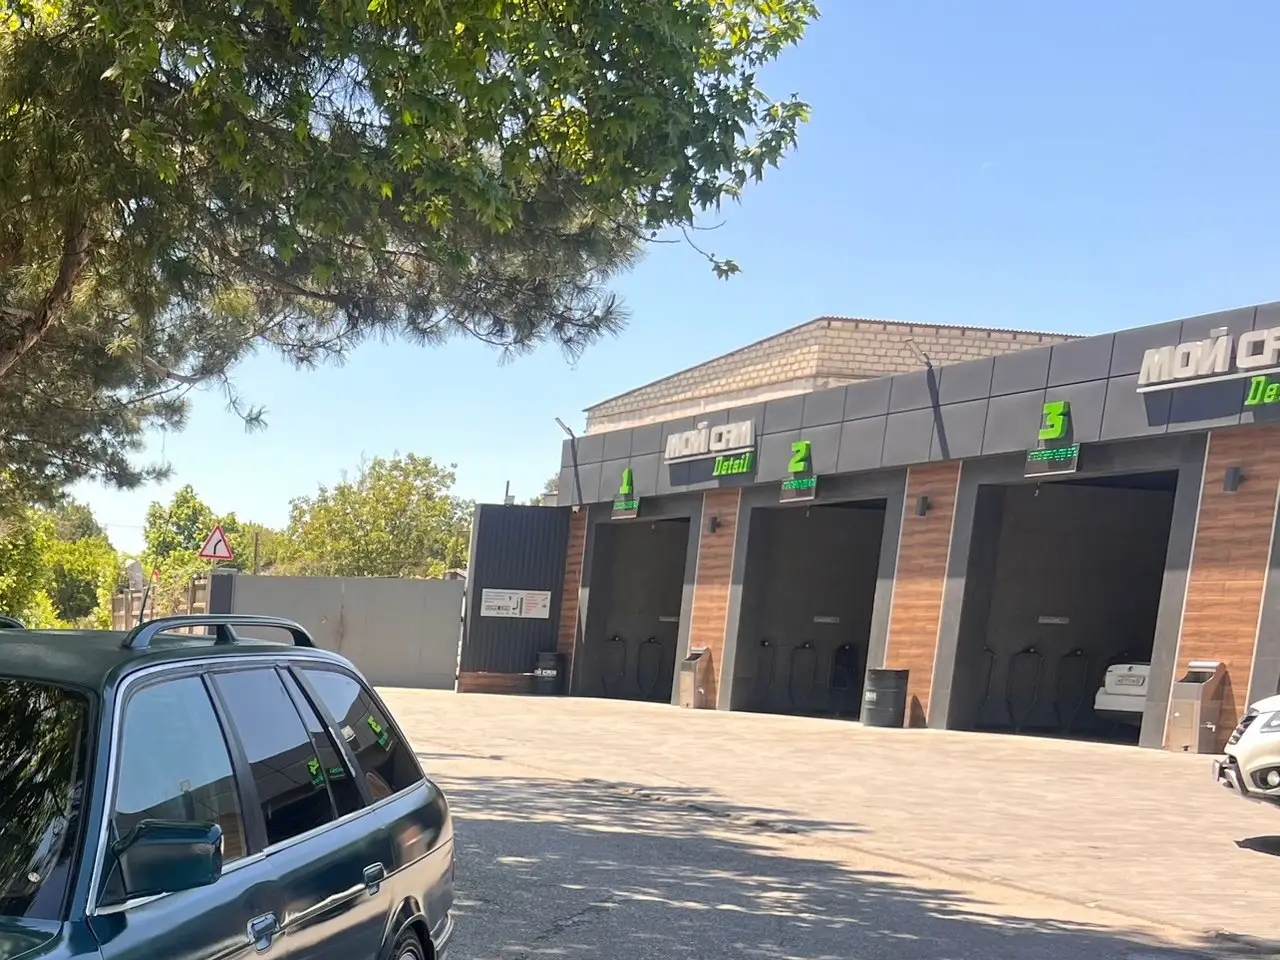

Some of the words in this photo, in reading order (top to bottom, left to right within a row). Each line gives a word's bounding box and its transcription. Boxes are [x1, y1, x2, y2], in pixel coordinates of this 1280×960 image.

[1138, 327, 1232, 384] МОЙ
[1244, 376, 1280, 405] De
[1039, 401, 1067, 440] 3
[665, 421, 709, 458] МОЙ
[712, 453, 751, 477] Detail
[788, 440, 812, 473] 2
[620, 467, 633, 495] 1
